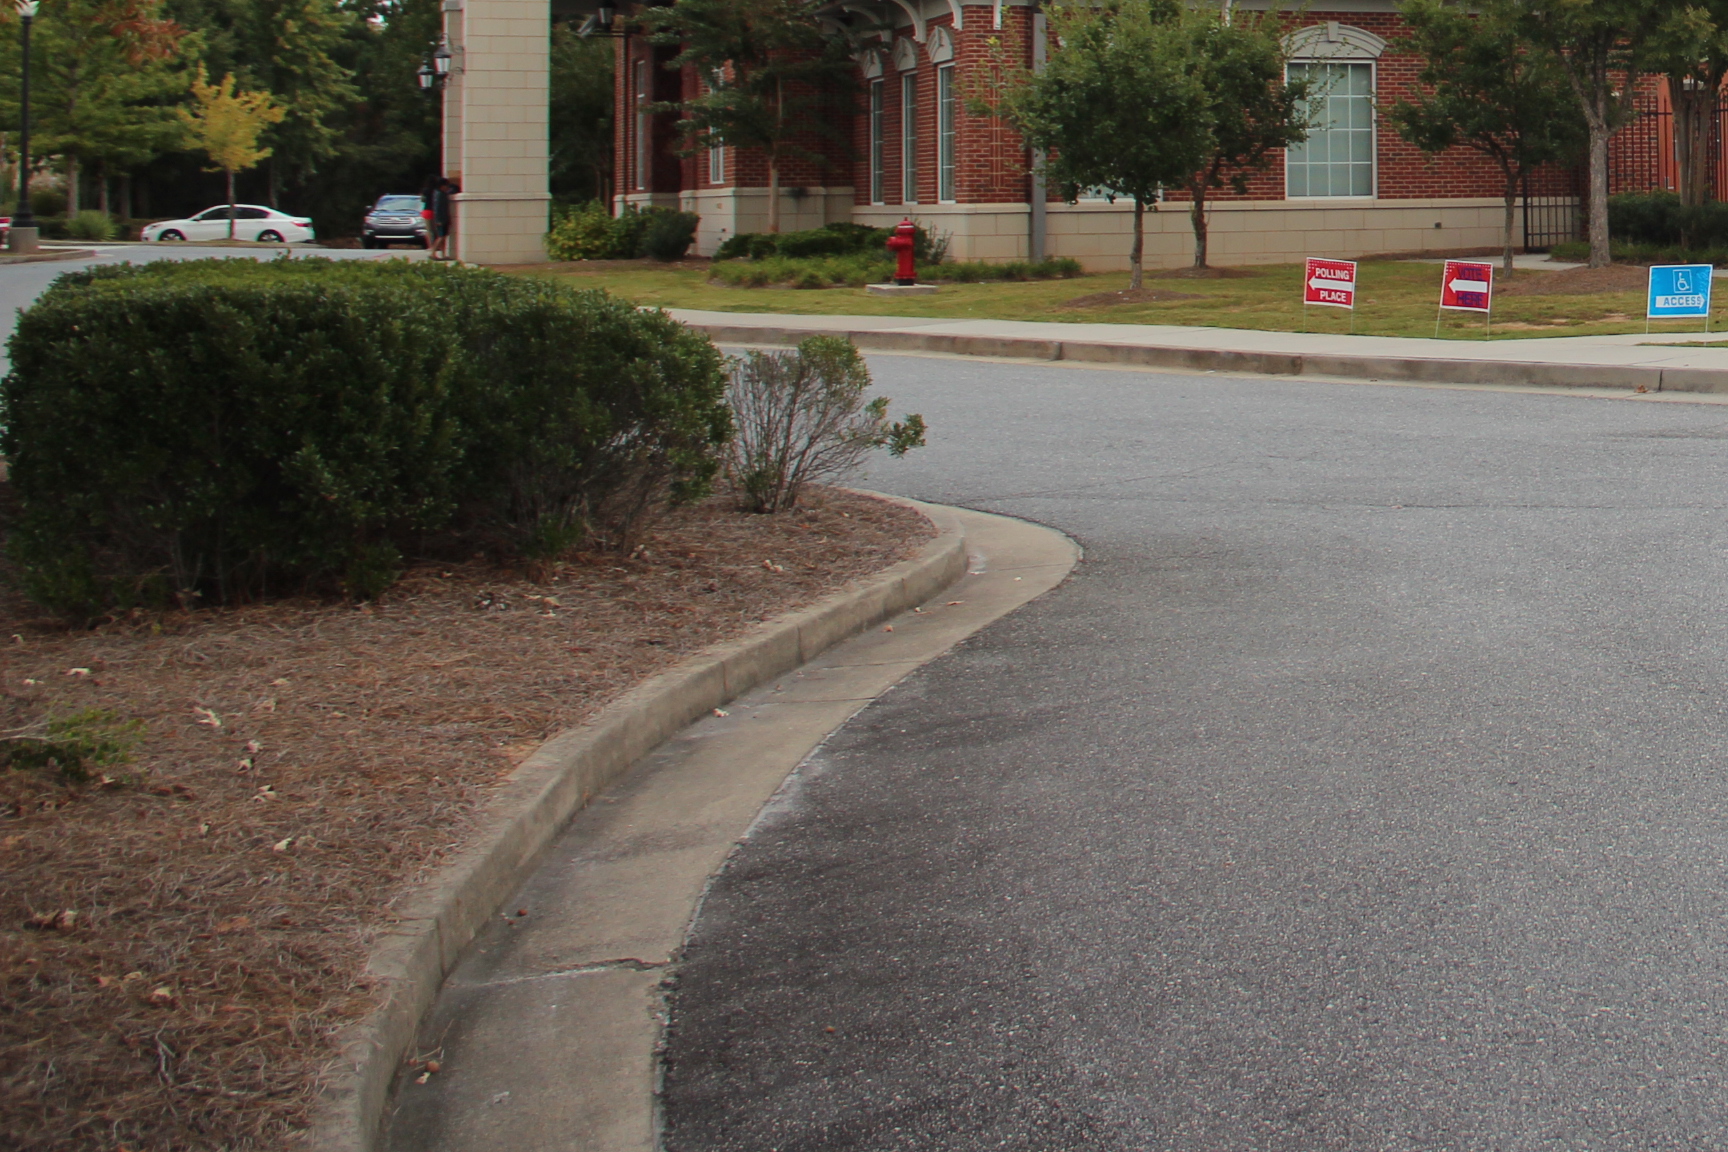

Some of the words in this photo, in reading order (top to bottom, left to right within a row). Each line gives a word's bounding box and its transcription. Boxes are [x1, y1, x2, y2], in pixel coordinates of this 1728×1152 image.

[1315, 267, 1350, 280] POLLING
[1457, 267, 1482, 281] VOTE
[1320, 290, 1347, 302] PLACE
[1663, 296, 1702, 306] ACCESS
